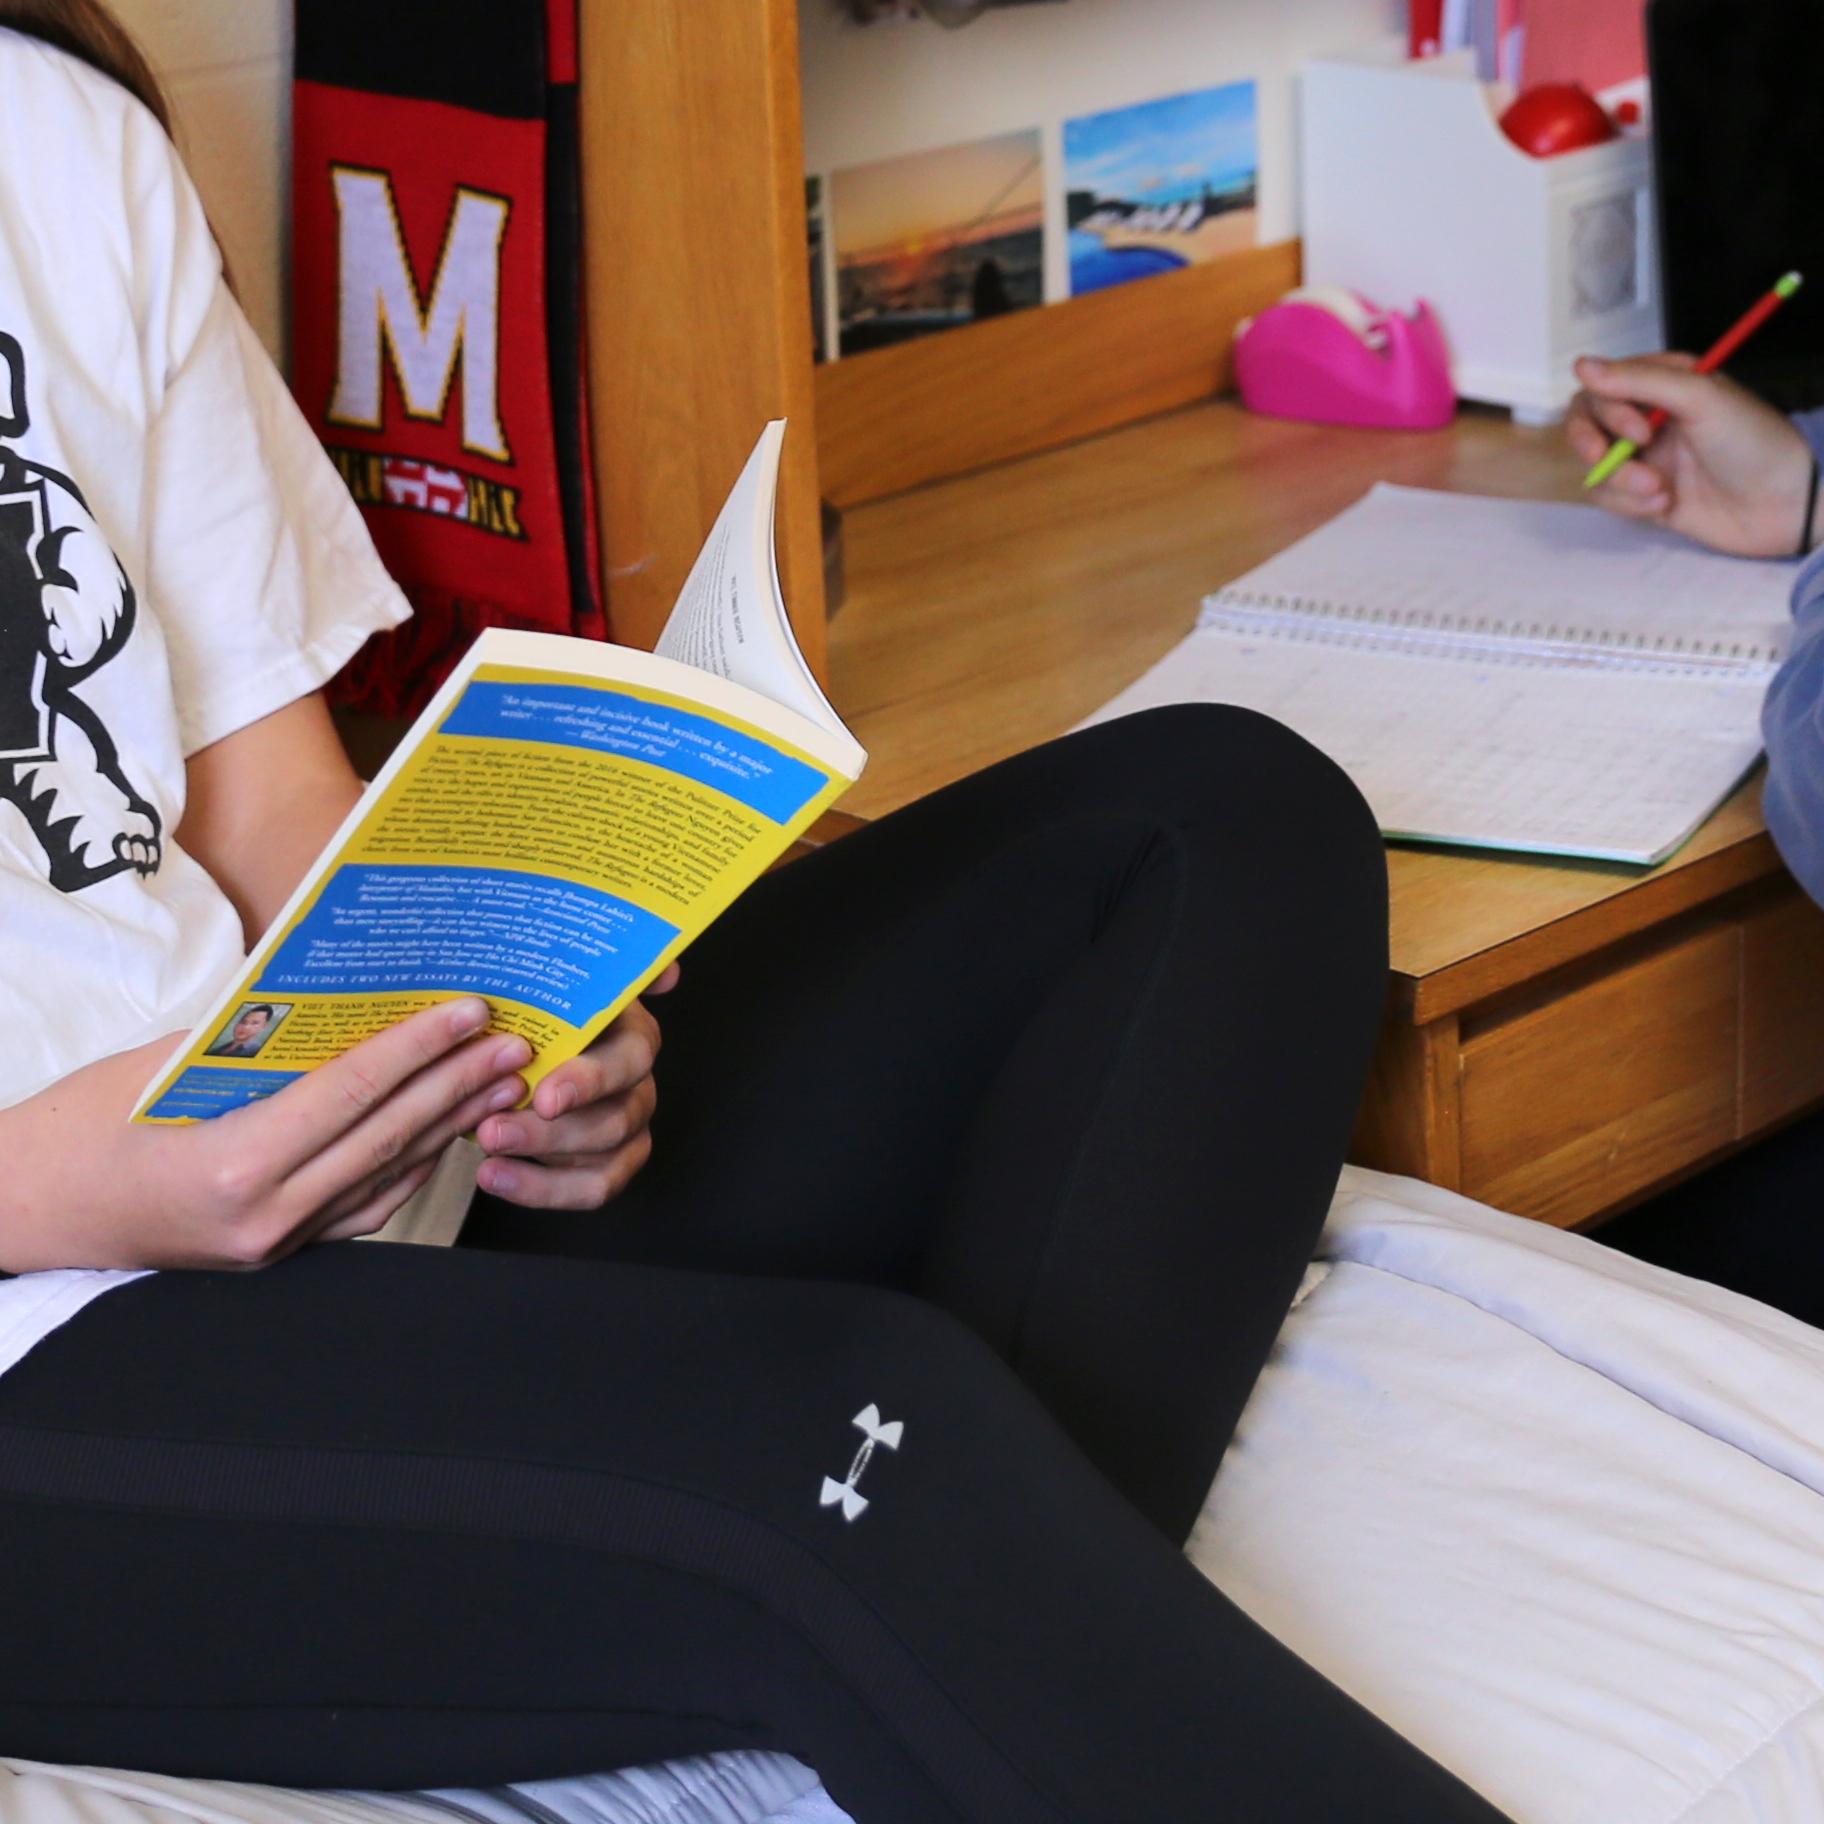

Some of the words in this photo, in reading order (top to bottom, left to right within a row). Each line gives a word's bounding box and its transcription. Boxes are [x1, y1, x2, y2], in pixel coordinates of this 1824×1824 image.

[326, 162, 514, 465] M
[608, 726, 629, 734] and
[641, 718, 669, 731] book
[672, 729, 711, 746] written
[712, 742, 727, 754] by
[738, 755, 772, 774] major
[279, 975, 345, 983] INCLUDES
[349, 975, 379, 983] TWO
[461, 974, 478, 982] BY
[482, 977, 510, 987] THE
[515, 984, 573, 1010] AUTHOR
